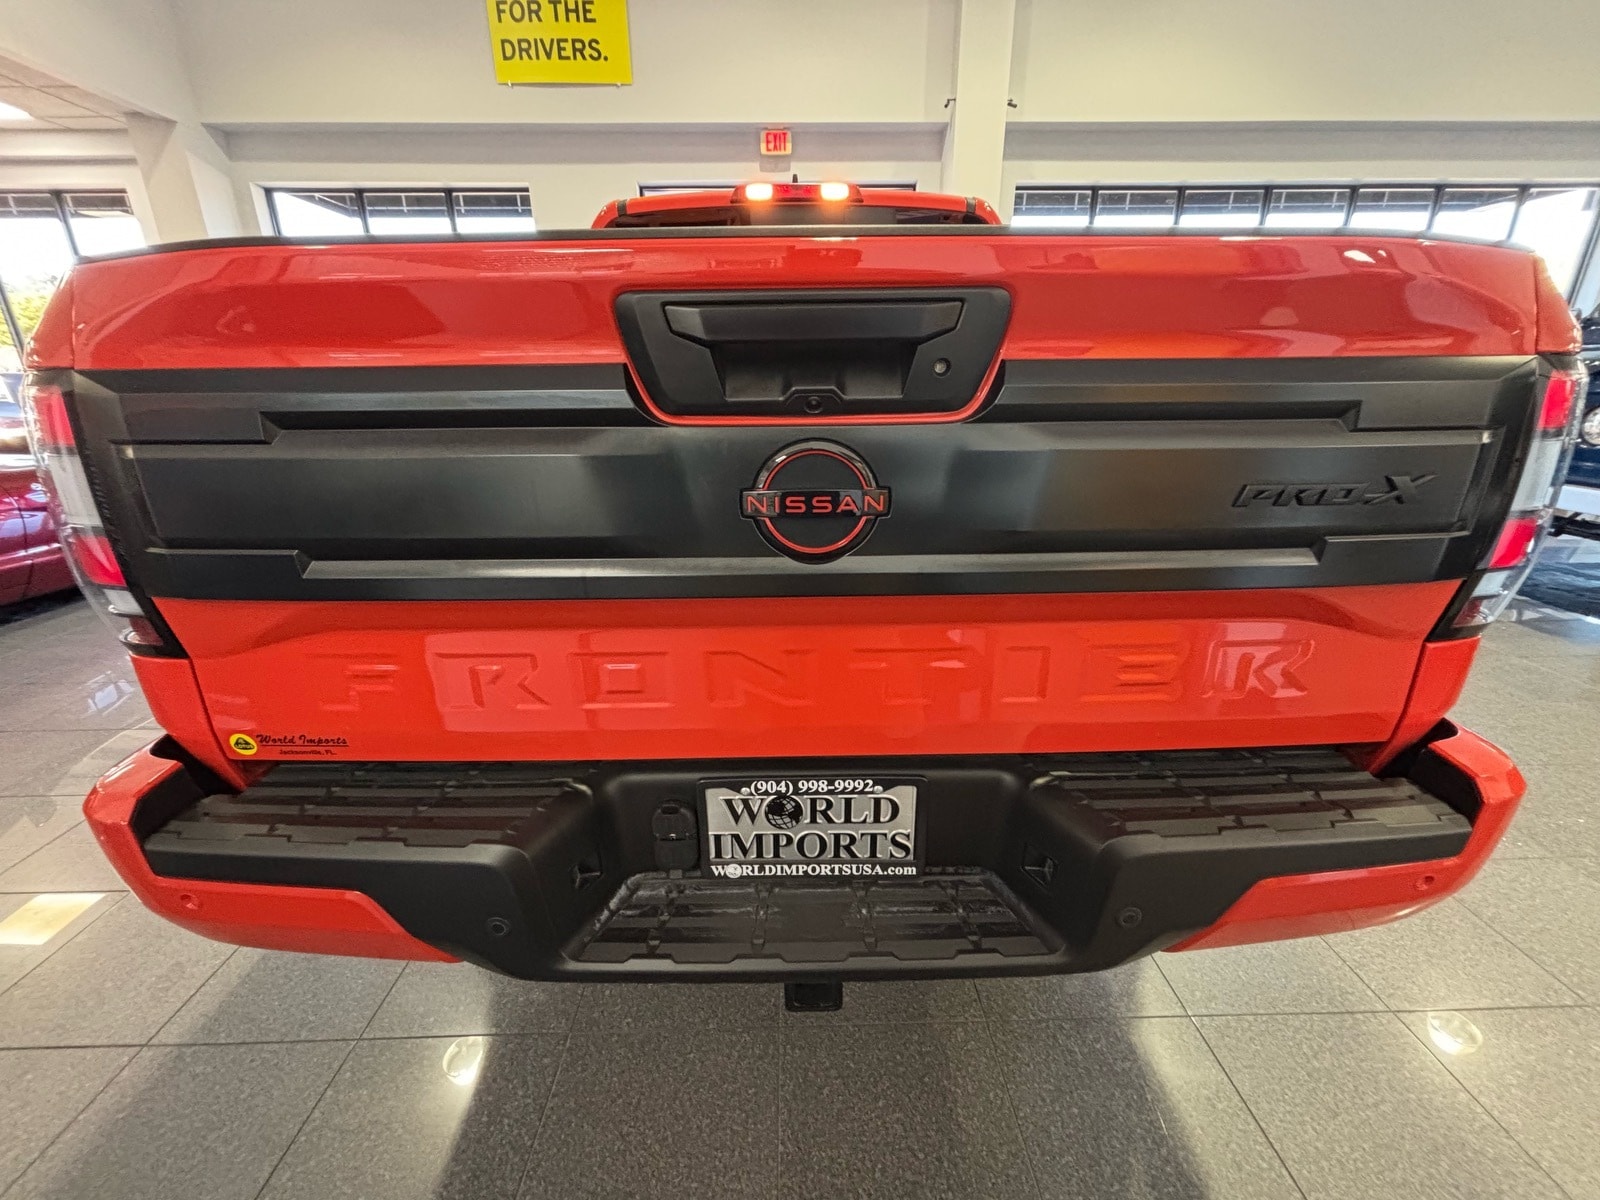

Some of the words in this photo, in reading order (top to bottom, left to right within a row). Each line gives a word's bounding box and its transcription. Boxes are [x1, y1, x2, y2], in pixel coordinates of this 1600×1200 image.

[495, 0, 543, 23] FOR
[548, 0, 597, 23] THE
[500, 37, 609, 62] DRIVERS.
[765, 131, 788, 152] EXIT
[746, 494, 885, 514] NISSAN
[303, 639, 1315, 711] FRONTIER
[256, 734, 297, 744] World
[298, 734, 348, 746] Imports
[750, 780, 794, 796] (904)
[798, 779, 874, 793] 998-9992
[719, 795, 900, 830] WORLD
[708, 830, 912, 860] IMPORTS
[710, 862, 917, 879] WORLDIMPORTSUSA.com
